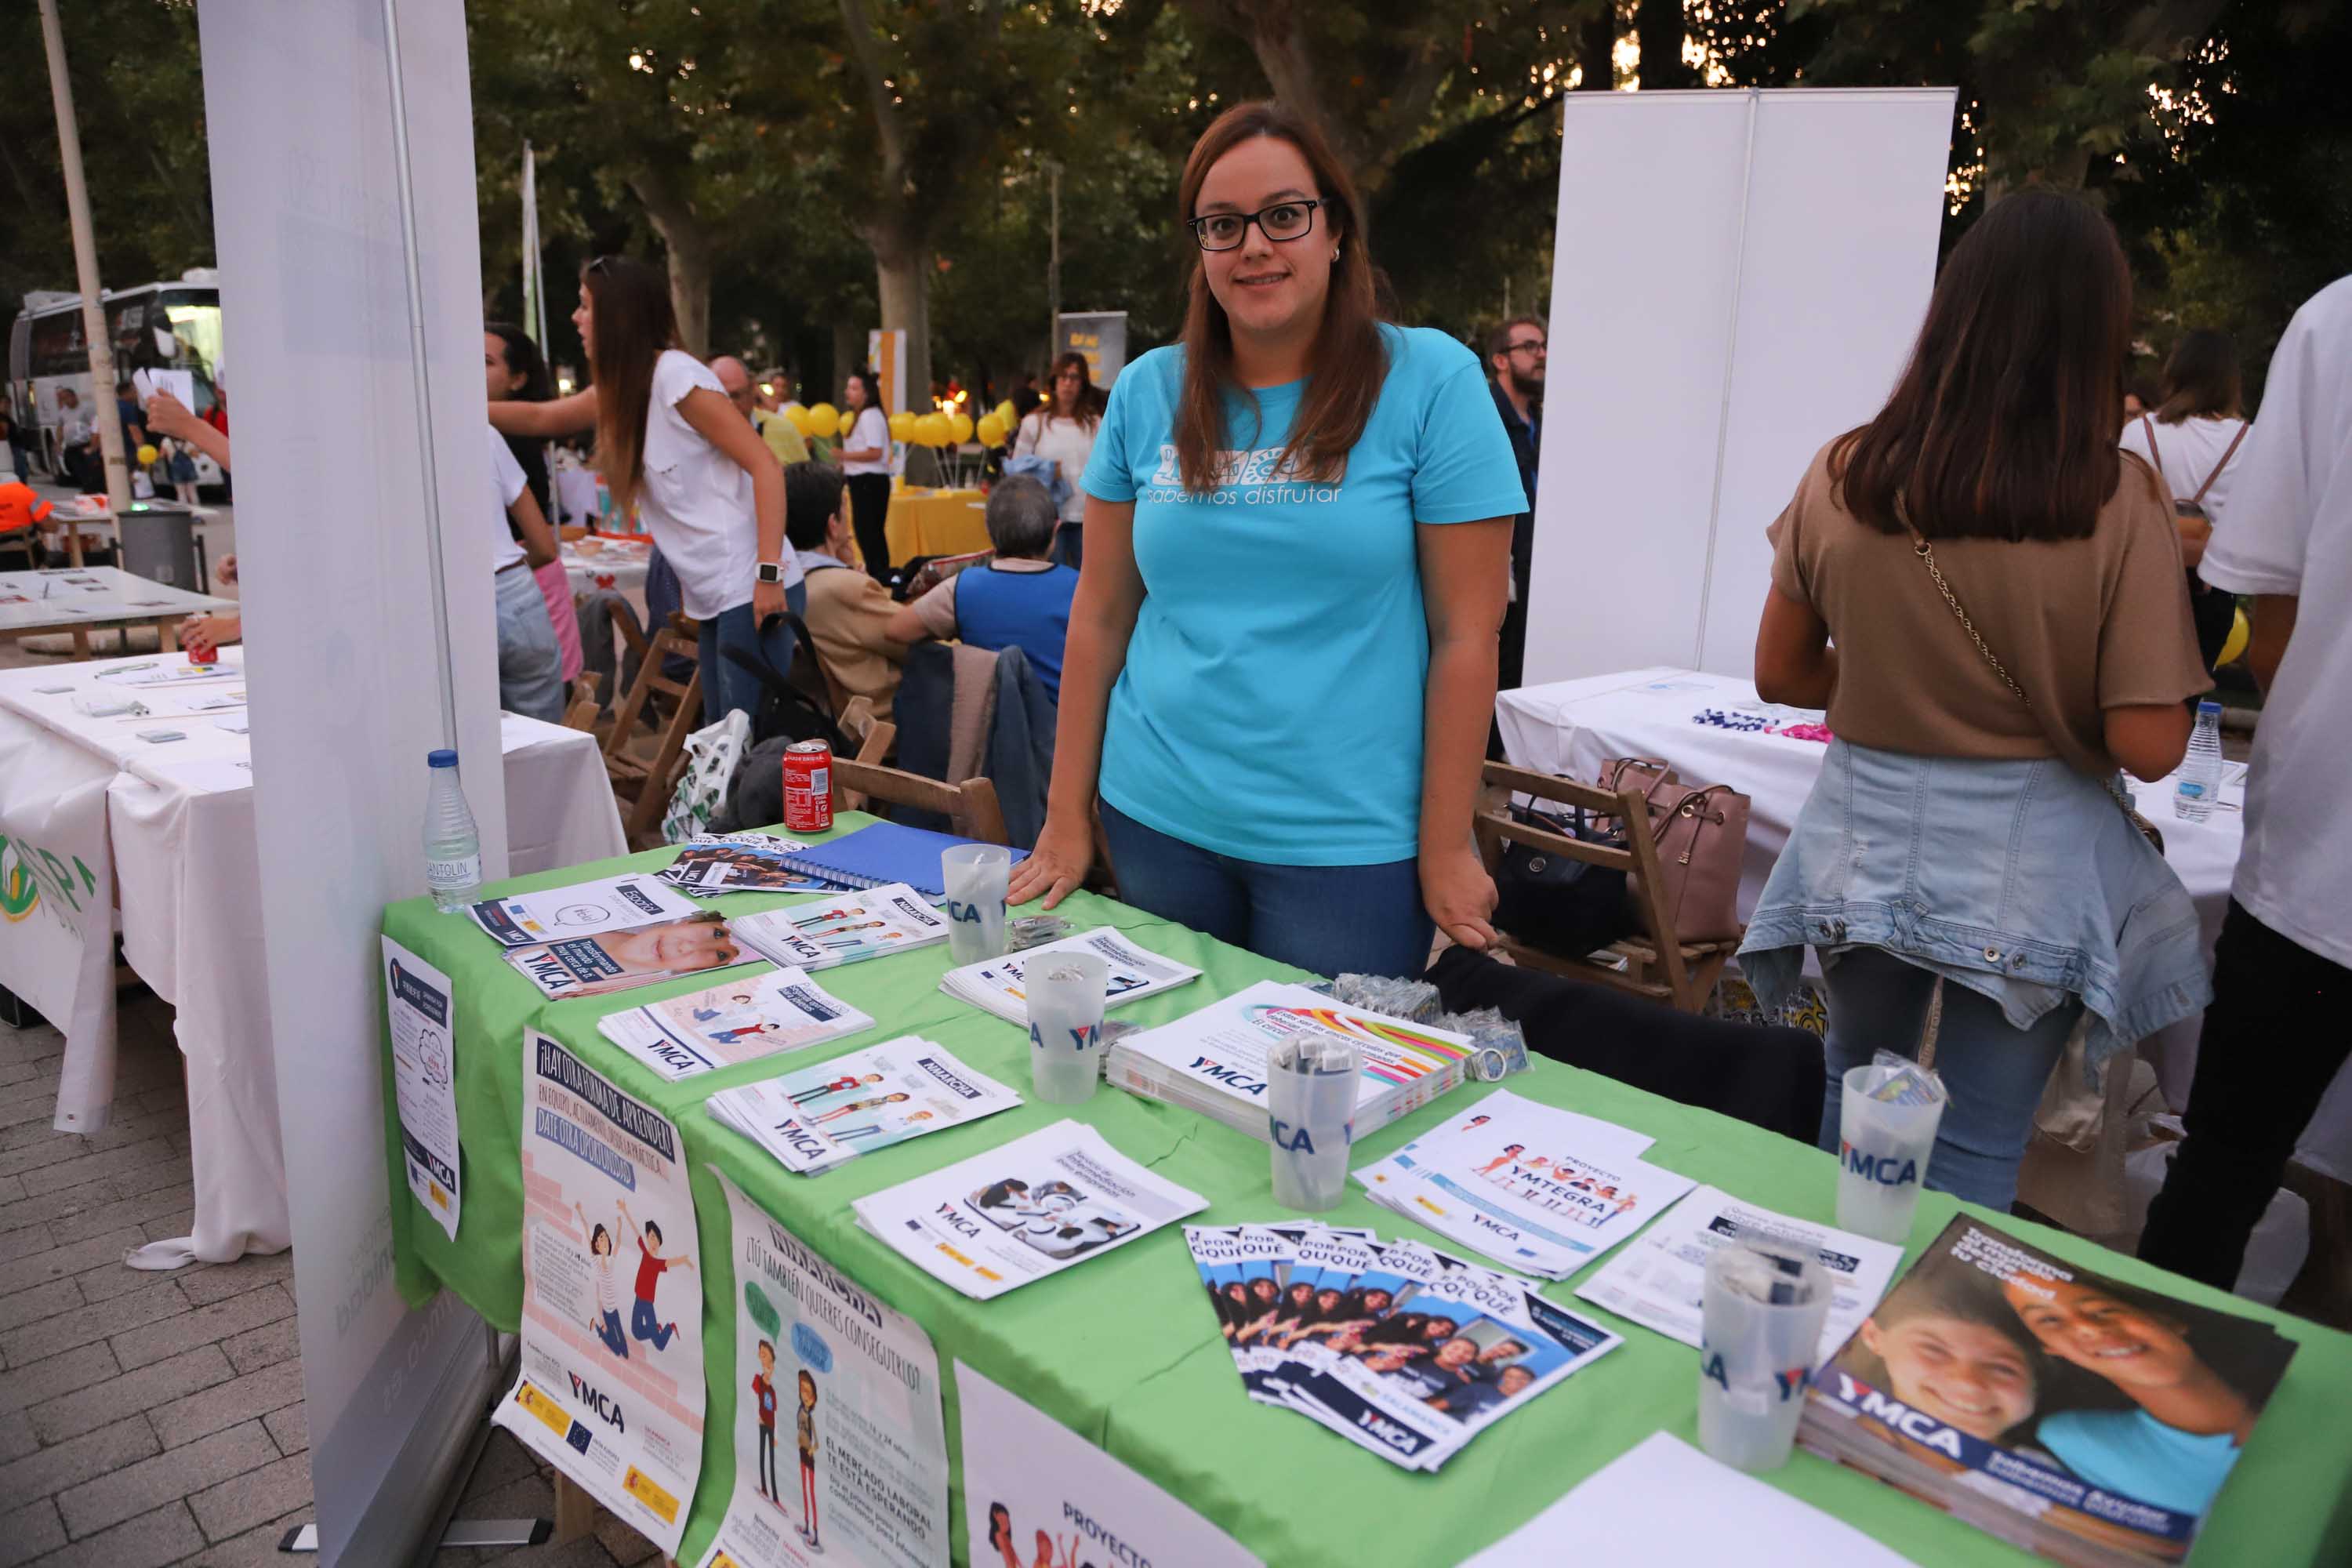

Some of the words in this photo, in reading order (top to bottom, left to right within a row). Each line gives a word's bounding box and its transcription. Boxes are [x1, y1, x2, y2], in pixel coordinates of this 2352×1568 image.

[1244, 484, 1342, 504] disfrutar
[624, 890, 659, 913] Español
[554, 946, 569, 959] muy
[566, 956, 582, 970] cerca
[573, 949, 593, 966] mundo
[580, 941, 619, 974] Transformando
[781, 935, 821, 959] YMCA
[524, 953, 576, 990] YMCA
[647, 1039, 696, 1070] YMCA
[1383, 1048, 1403, 1059] que
[924, 1062, 974, 1097] NMARCHA
[1189, 1056, 1269, 1096] YMCA
[539, 1083, 548, 1103] EN
[540, 1043, 561, 1080] ¡HAY
[562, 1054, 584, 1096] OTRA
[583, 1071, 610, 1116] FORMA
[608, 1090, 622, 1123] DE
[622, 1098, 673, 1156] APRENDER!
[538, 1109, 559, 1140] DATE
[559, 1116, 579, 1149] OTRA
[579, 1129, 632, 1184] OPORTUNIDAD
[775, 1118, 827, 1160] YMCA
[426, 1150, 453, 1189] YMCA
[1565, 1155, 1621, 1182] PROYECTO
[1512, 1164, 1606, 1214] YMTEGRA
[935, 1202, 981, 1239] YMCA
[1472, 1213, 1519, 1242] YMCA
[1243, 1242, 1285, 1254] QUÉ
[1244, 1235, 1276, 1244] POR
[1304, 1240, 1336, 1250] POR
[1337, 1246, 1370, 1259] POR
[1967, 1226, 2074, 1283] Transforma
[1392, 1257, 1434, 1279] QUÉ
[1403, 1250, 1433, 1267] POR
[1490, 1283, 1519, 1304] POR
[1975, 1260, 2057, 1301] ciudad
[746, 1236, 761, 1268] ¿TÚ
[762, 1249, 804, 1302] TAMBIÉN
[806, 1284, 844, 1334] QUIERES
[844, 1316, 922, 1395] CONSEGUIRLO?
[1474, 1288, 1517, 1316] QUÉ
[567, 1369, 625, 1435] YMCA
[1838, 1372, 1962, 1459] YMCA
[1357, 1409, 1418, 1455] YMCA
[826, 1436, 836, 1451] EL
[837, 1446, 886, 1492] MERCADO
[886, 1486, 933, 1531] LABORAL
[827, 1452, 837, 1468] TE
[840, 1461, 864, 1490] ESTÁ
[865, 1482, 926, 1540] ESPERANDO
[1063, 1500, 1152, 1568] PROYECTO
